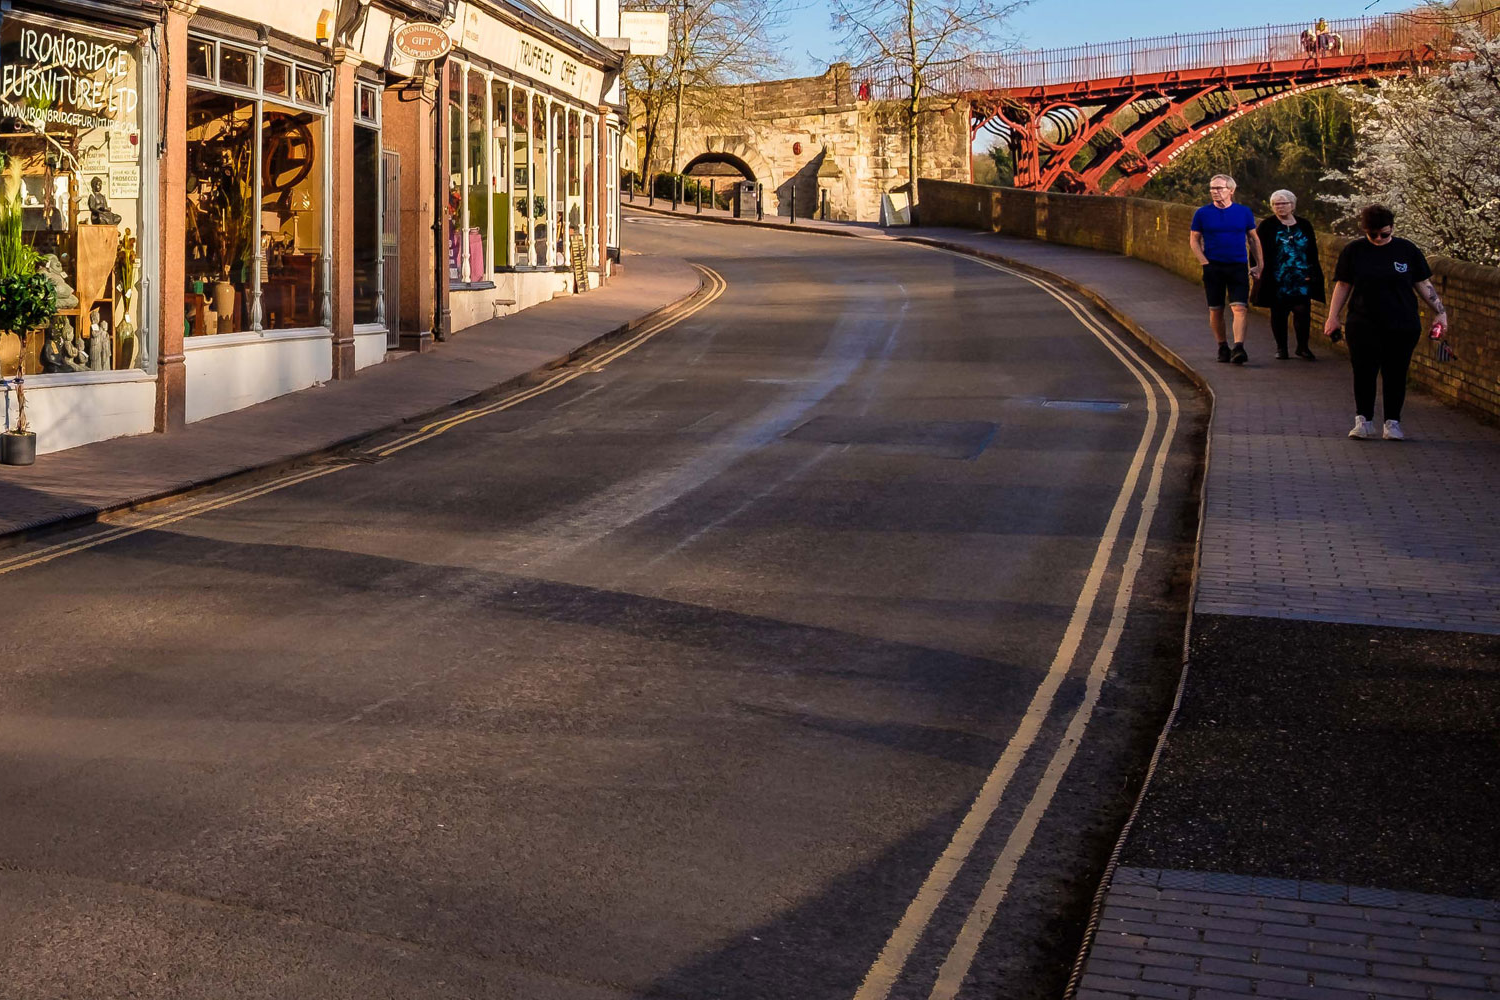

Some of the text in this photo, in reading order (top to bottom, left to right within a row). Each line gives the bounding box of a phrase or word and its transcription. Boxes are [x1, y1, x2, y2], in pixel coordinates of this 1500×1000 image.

[20, 28, 128, 78] IRONBRIDGE
[401, 25, 446, 40] IRONBRIDGE
[401, 45, 441, 57] EMPORIUM
[411, 36, 433, 46] GIFT
[520, 40, 577, 86] TRUFFLES CAFE
[2, 65, 139, 113] FURNITURE LTD
[1146, 163, 1164, 178] THIS
[1167, 139, 1194, 160] BRIDGE
[1200, 124, 1218, 136] WAS
[1223, 110, 1244, 123] CAST
